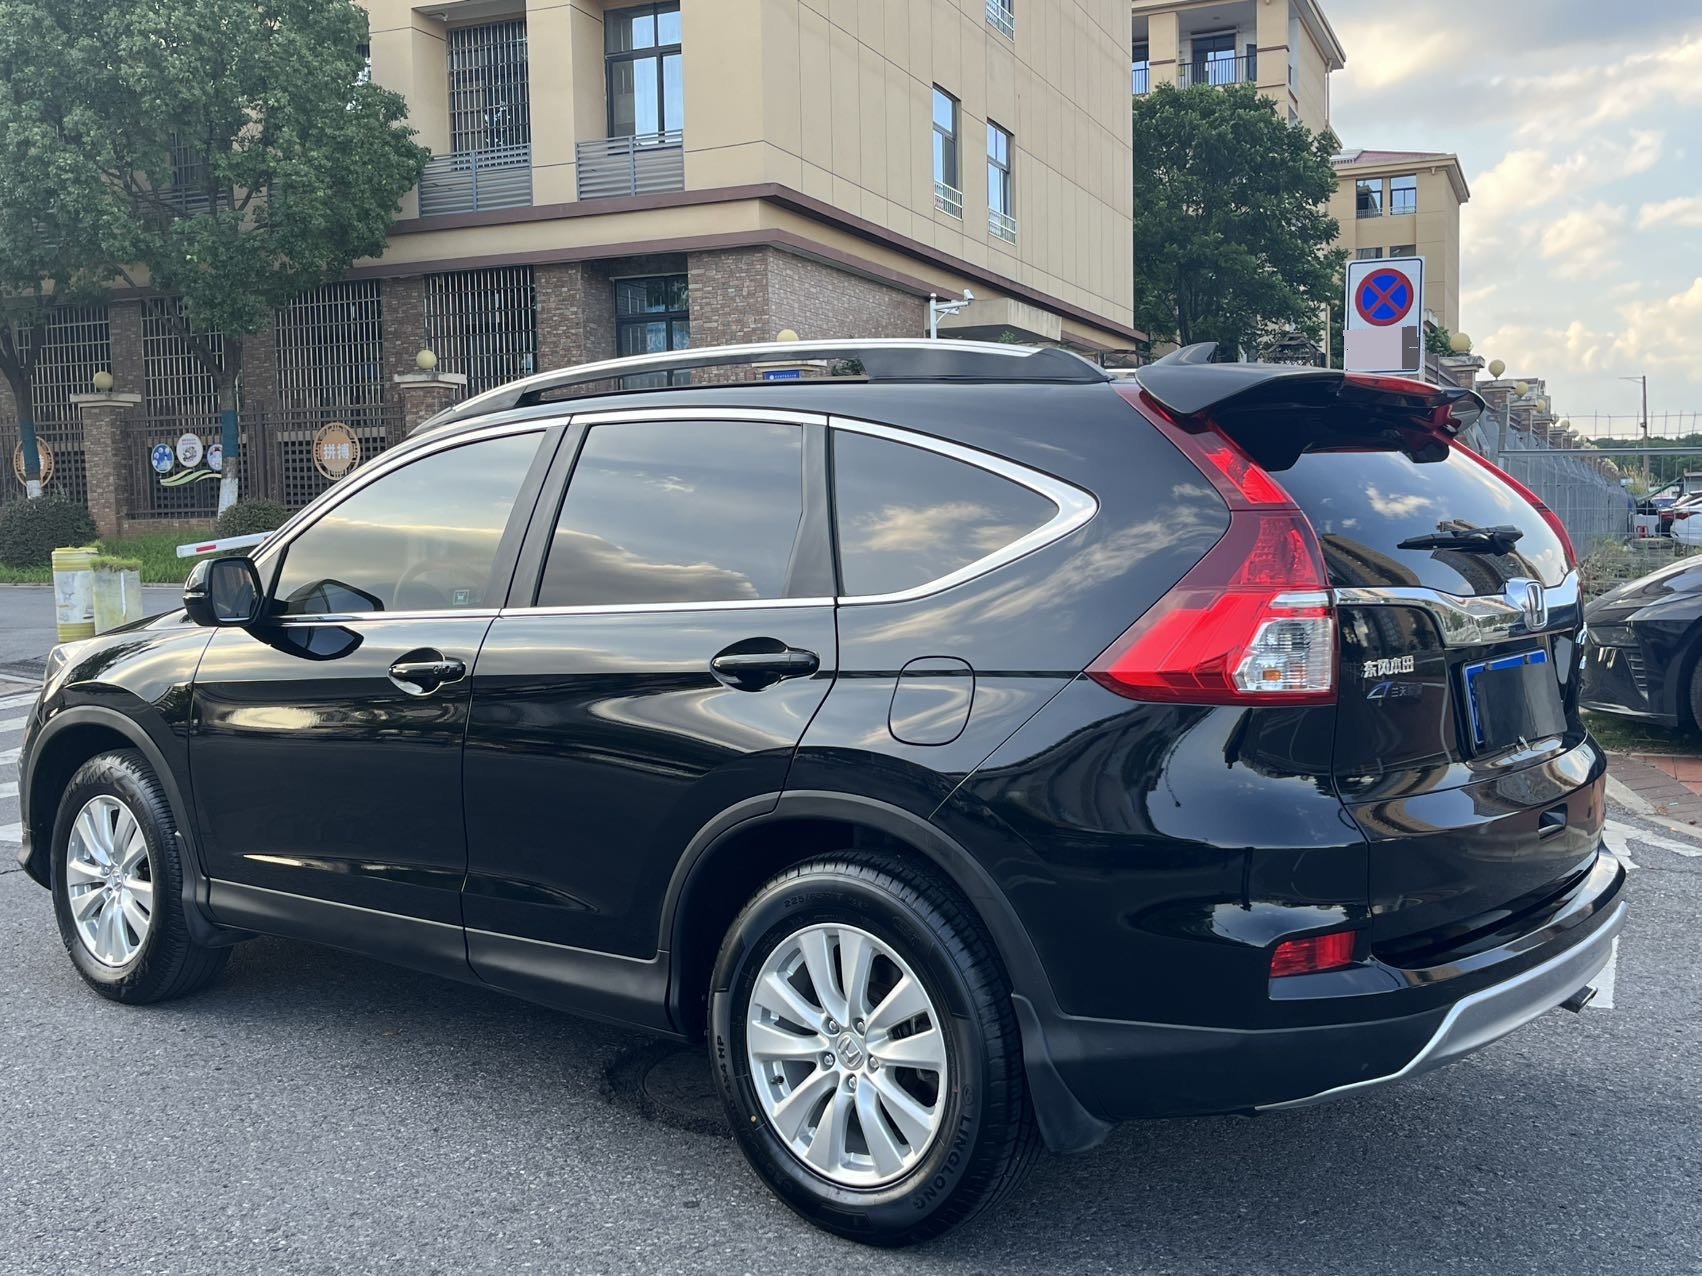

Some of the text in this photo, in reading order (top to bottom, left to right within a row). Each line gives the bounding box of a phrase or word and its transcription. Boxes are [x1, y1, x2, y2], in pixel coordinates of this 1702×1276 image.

[1363, 655, 1415, 679] 东风本田
[912, 1113, 973, 1210] LINGLONG
